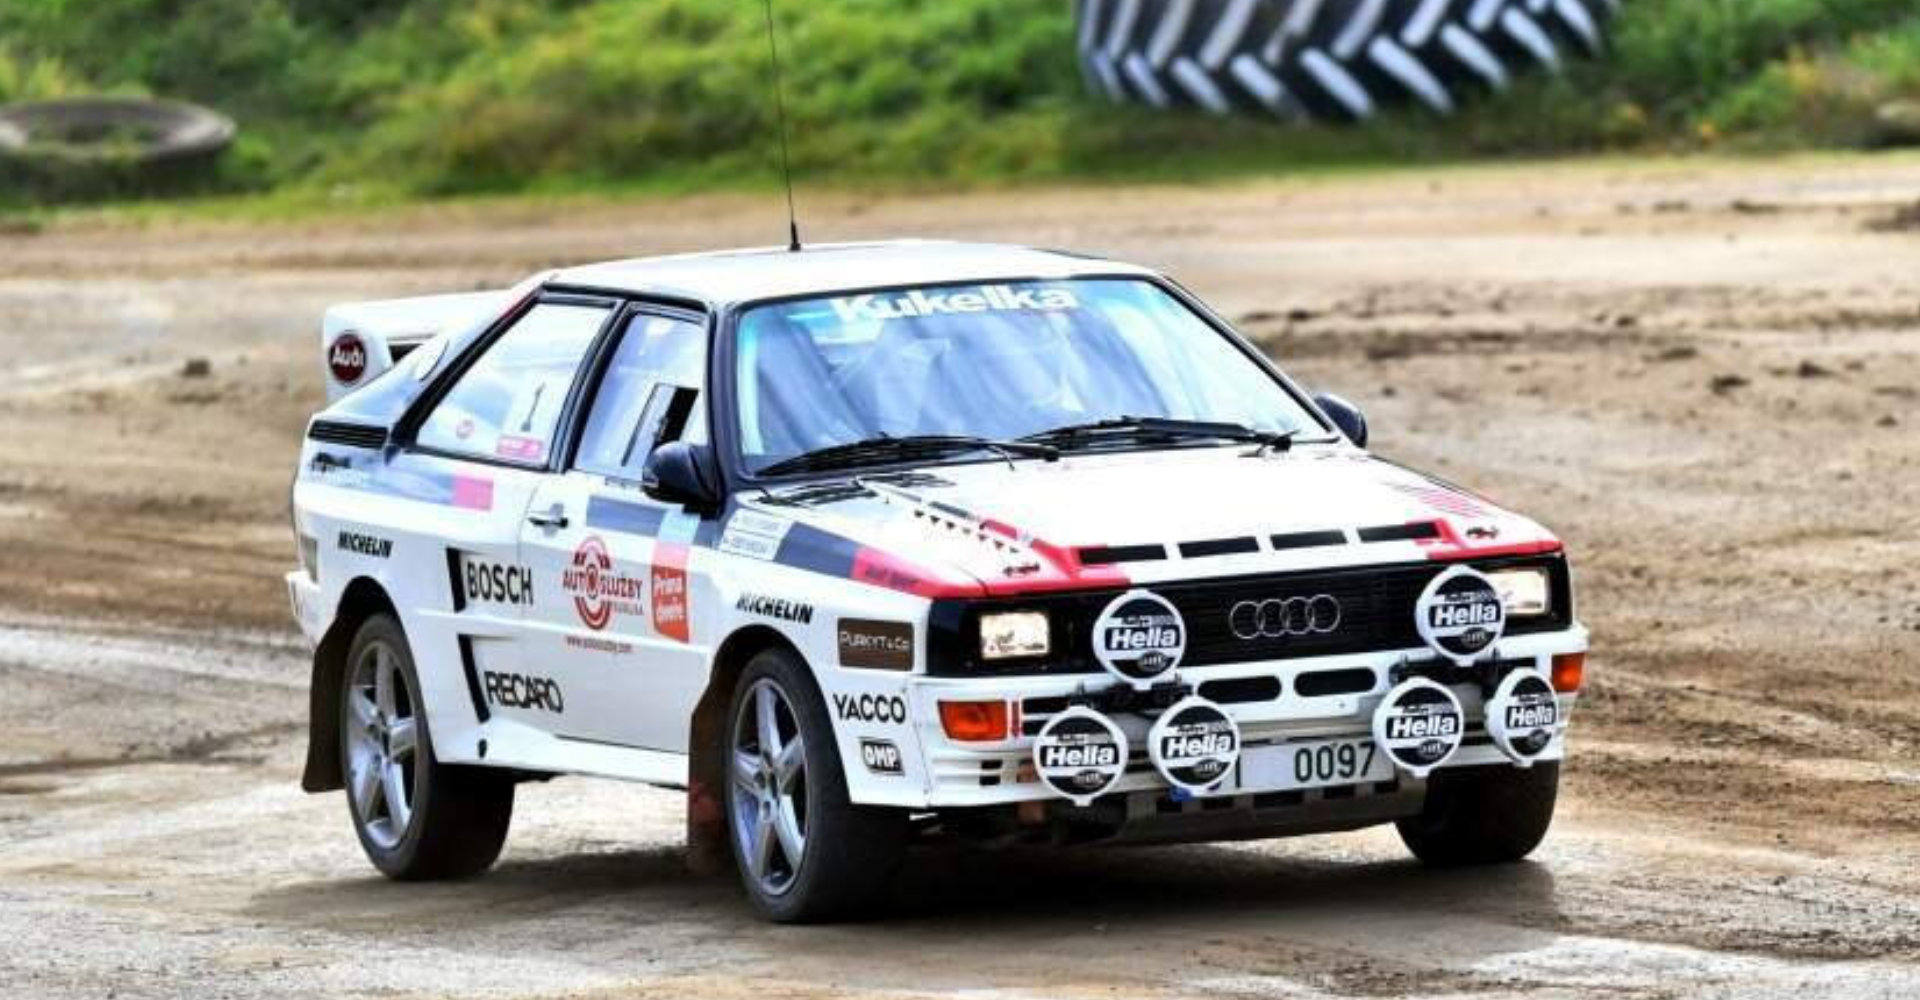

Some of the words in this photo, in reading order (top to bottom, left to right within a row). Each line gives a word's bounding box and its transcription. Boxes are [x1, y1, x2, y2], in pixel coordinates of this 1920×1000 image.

[830, 284, 1079, 323] Kukelka
[333, 344, 364, 367] Audi
[337, 531, 393, 559] MICHELIN
[467, 560, 533, 606] BOSCH
[735, 592, 813, 625] MICHELIN
[1435, 602, 1497, 626] Hella
[1111, 626, 1176, 649] Hella
[485, 671, 563, 714] RECARO
[833, 693, 905, 724] YACCO
[1509, 703, 1553, 729] Hella
[1391, 714, 1454, 737] Hella
[864, 743, 898, 768] OMP
[1046, 744, 1114, 767] Hella
[1167, 732, 1231, 757] Hella
